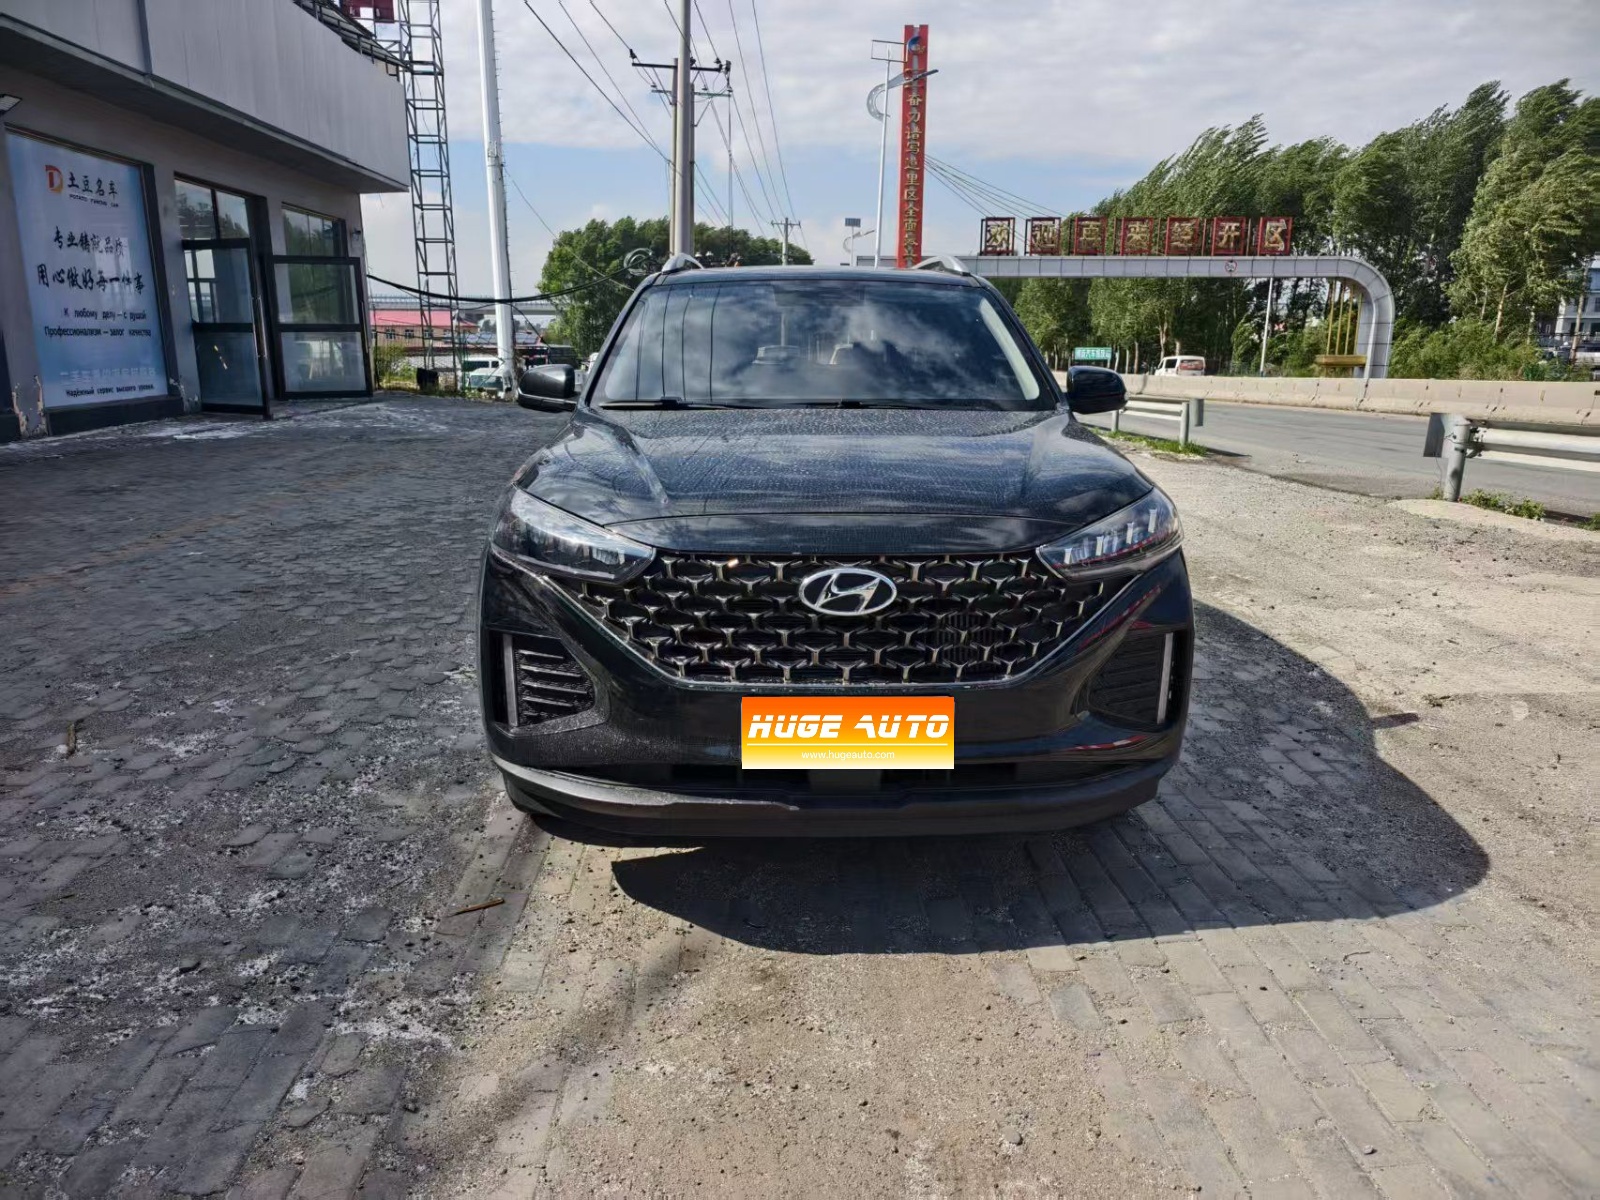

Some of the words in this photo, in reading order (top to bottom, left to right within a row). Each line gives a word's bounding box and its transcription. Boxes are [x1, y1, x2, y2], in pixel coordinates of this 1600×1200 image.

[67, 171, 118, 201] 土豆名车
[37, 263, 145, 295] 用心做好每一件事
